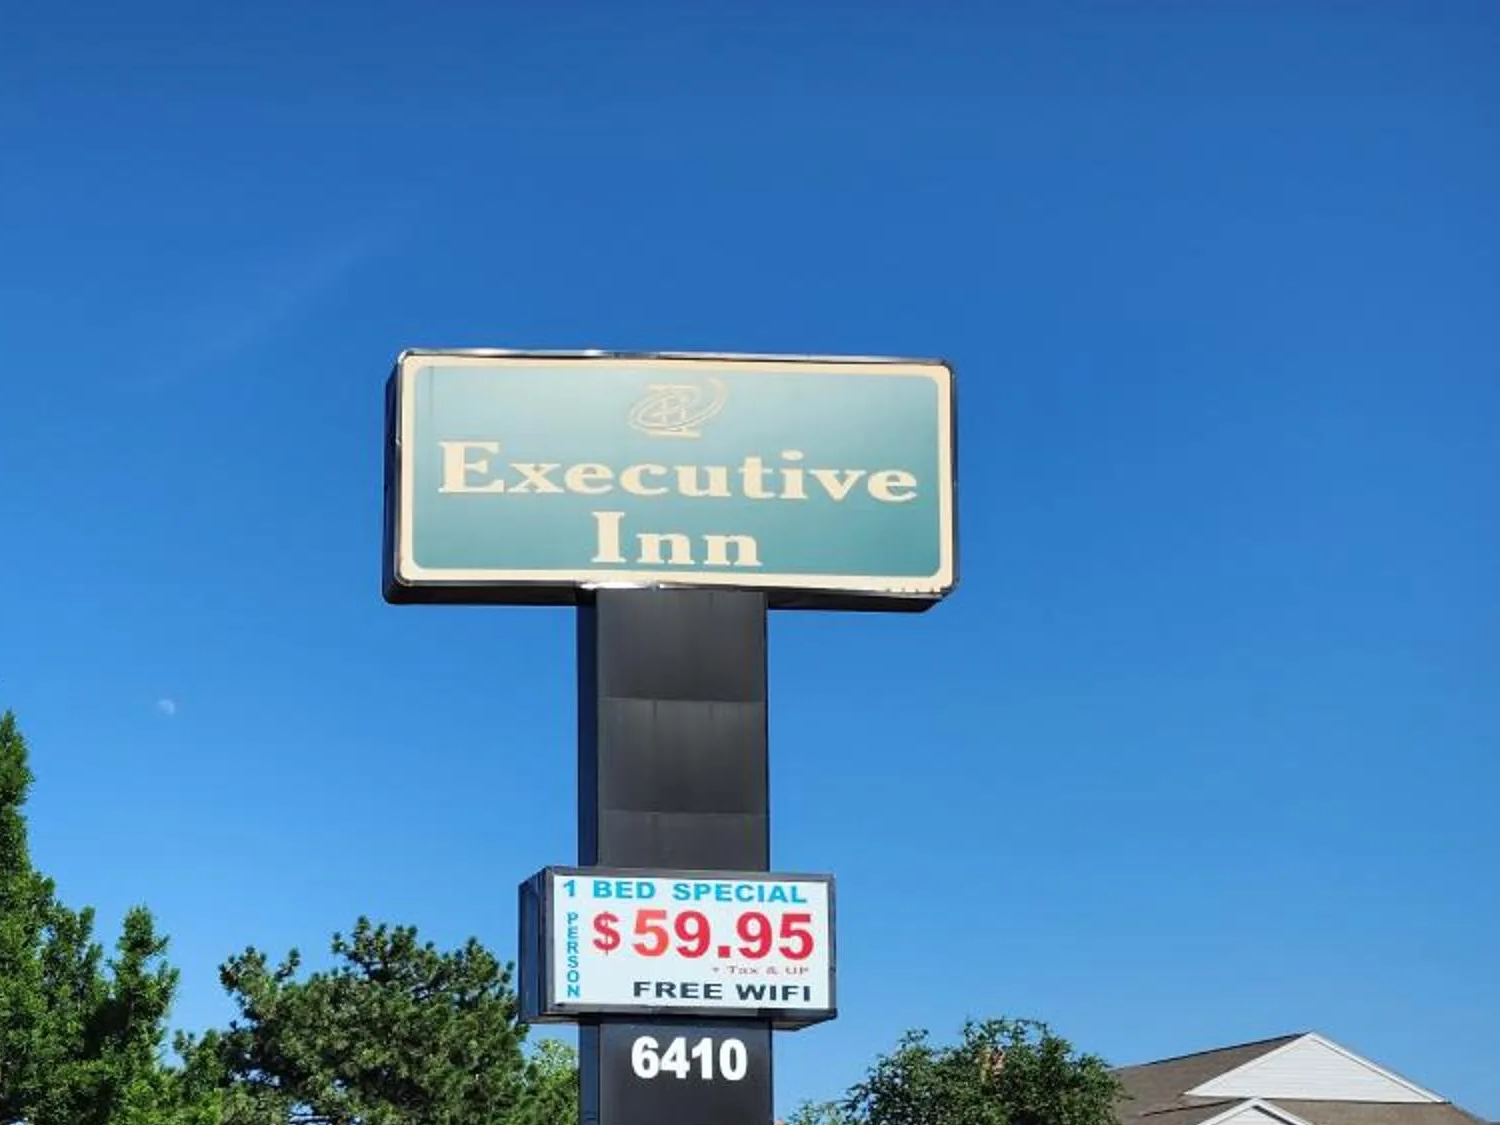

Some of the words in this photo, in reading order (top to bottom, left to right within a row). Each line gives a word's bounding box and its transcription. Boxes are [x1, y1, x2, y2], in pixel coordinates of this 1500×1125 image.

[437, 441, 918, 502] Executive
[591, 511, 762, 566] Inn
[563, 880, 576, 897] 1
[593, 880, 656, 899] BED
[672, 883, 806, 903] SPECIAL
[566, 912, 581, 998] PERSON
[633, 981, 723, 1001] FREE
[736, 983, 811, 1002] WIFI
[631, 1035, 747, 1080] 6410
